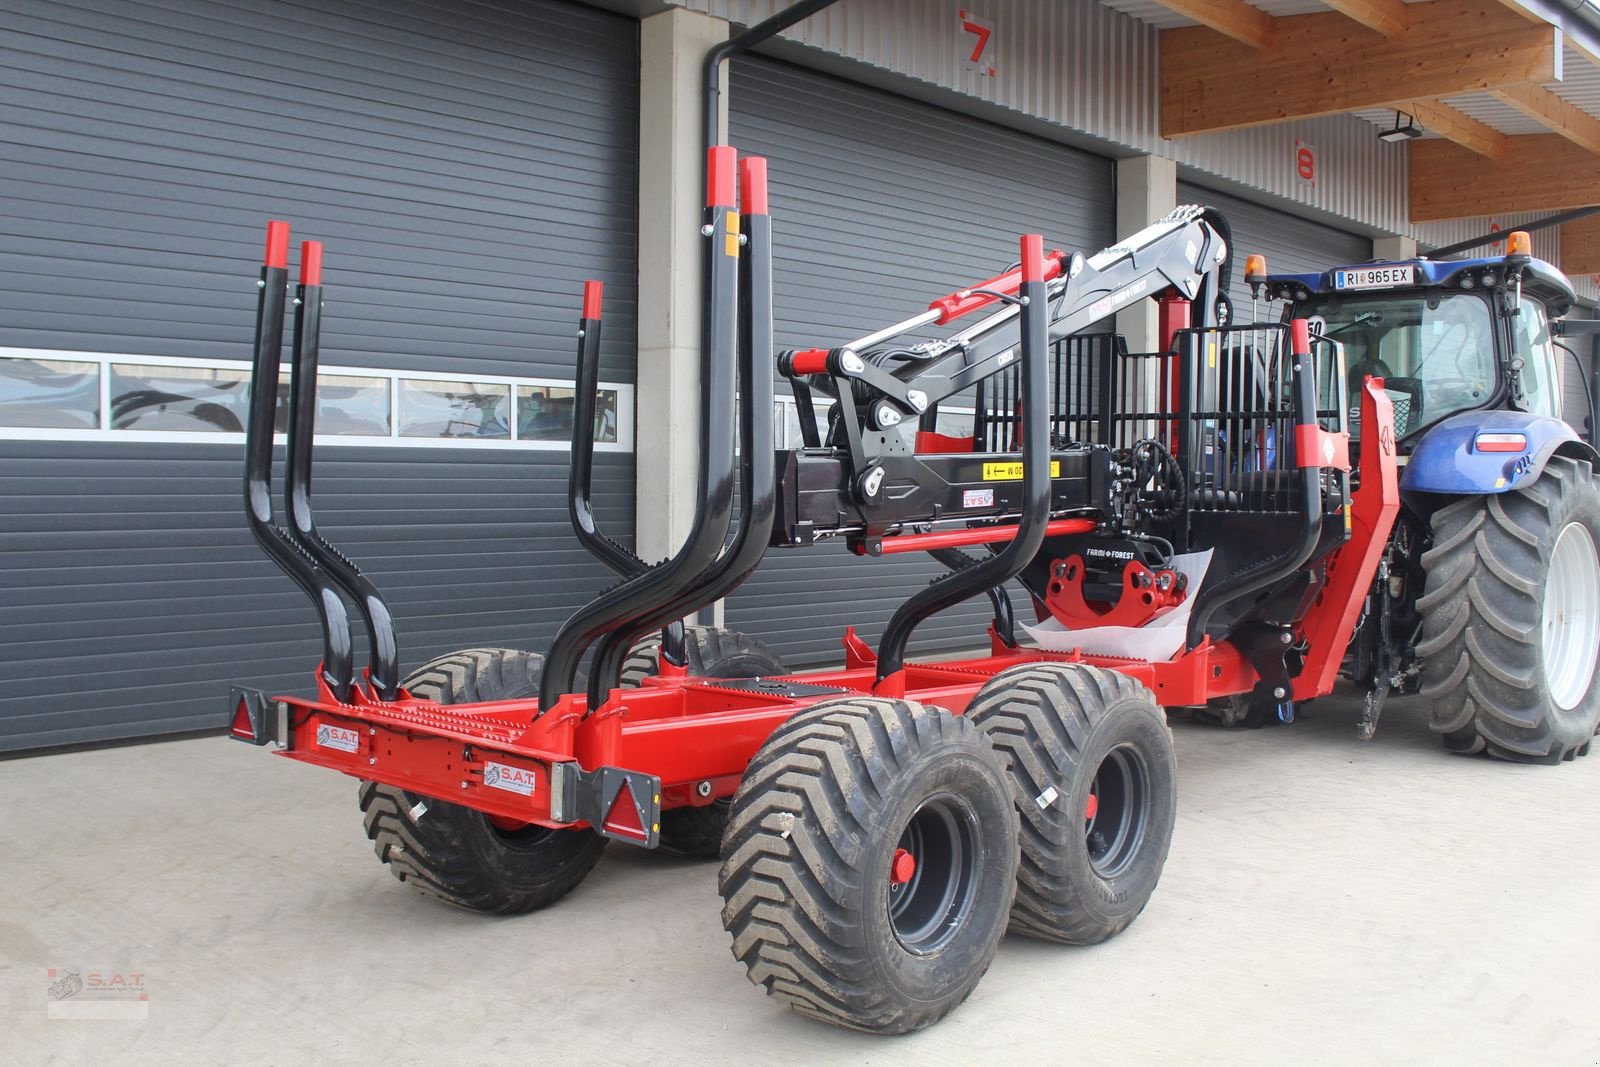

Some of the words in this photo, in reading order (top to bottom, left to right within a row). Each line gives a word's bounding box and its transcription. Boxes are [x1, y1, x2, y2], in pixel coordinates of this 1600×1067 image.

[963, 21, 992, 63] 7
[1297, 148, 1314, 179] 8
[1347, 273, 1359, 285] RI
[1367, 270, 1390, 284] 965
[1392, 269, 1407, 282] EX
[1086, 548, 1106, 557] FARMI
[1111, 550, 1135, 560] FOREST
[330, 728, 357, 743] S.A.T.
[501, 767, 534, 785] S.A.T.
